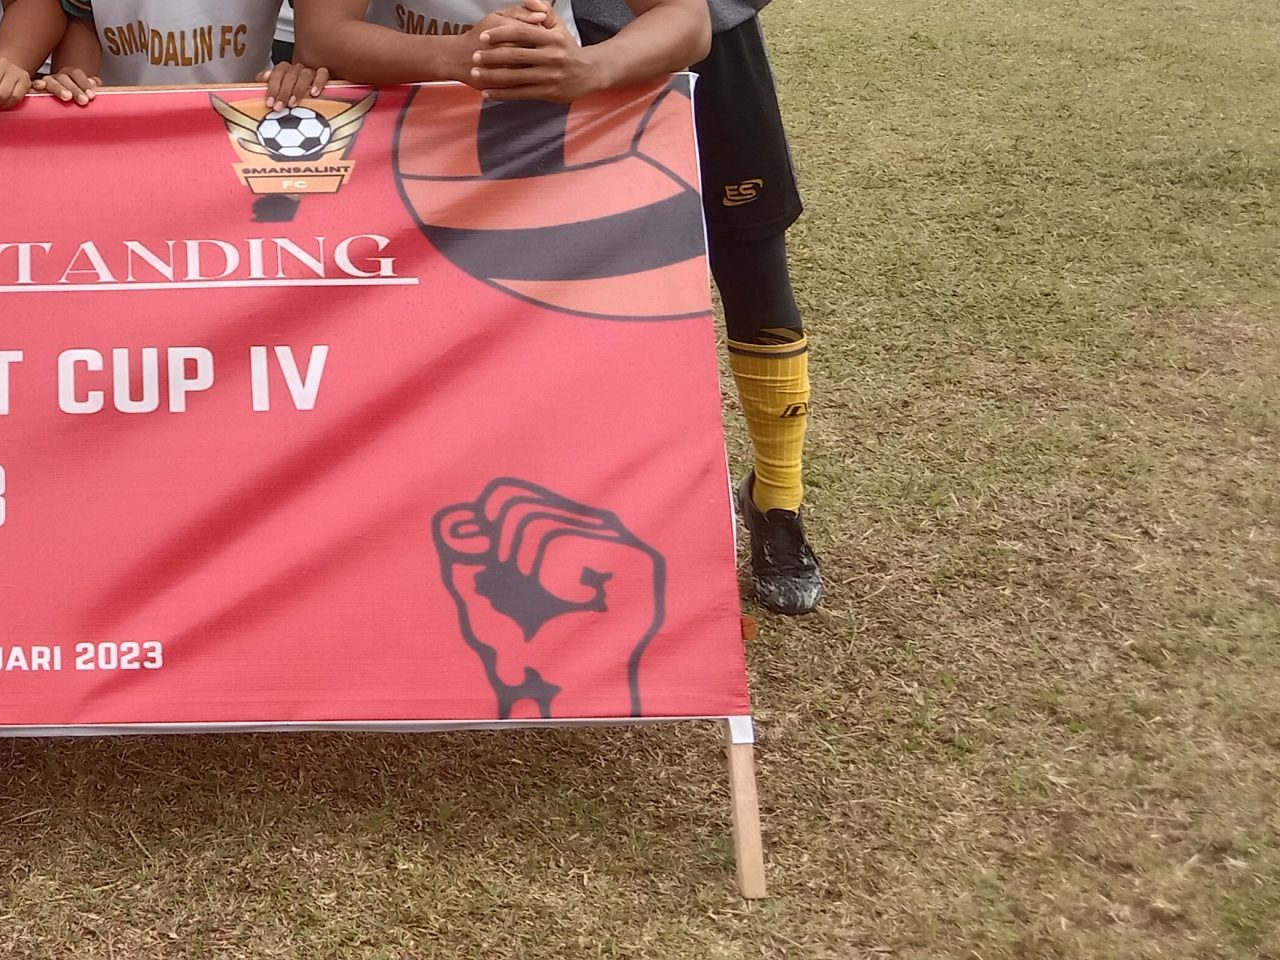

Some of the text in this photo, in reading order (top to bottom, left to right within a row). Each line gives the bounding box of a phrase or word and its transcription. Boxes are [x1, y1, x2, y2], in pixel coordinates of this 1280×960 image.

[219, 23, 248, 59] FC
[242, 166, 351, 175] SMANSALINT
[281, 180, 308, 189] FC
[724, 182, 758, 201] ES
[57, 346, 215, 415] CUP
[249, 344, 329, 413] IV
[74, 641, 163, 671] 2023
